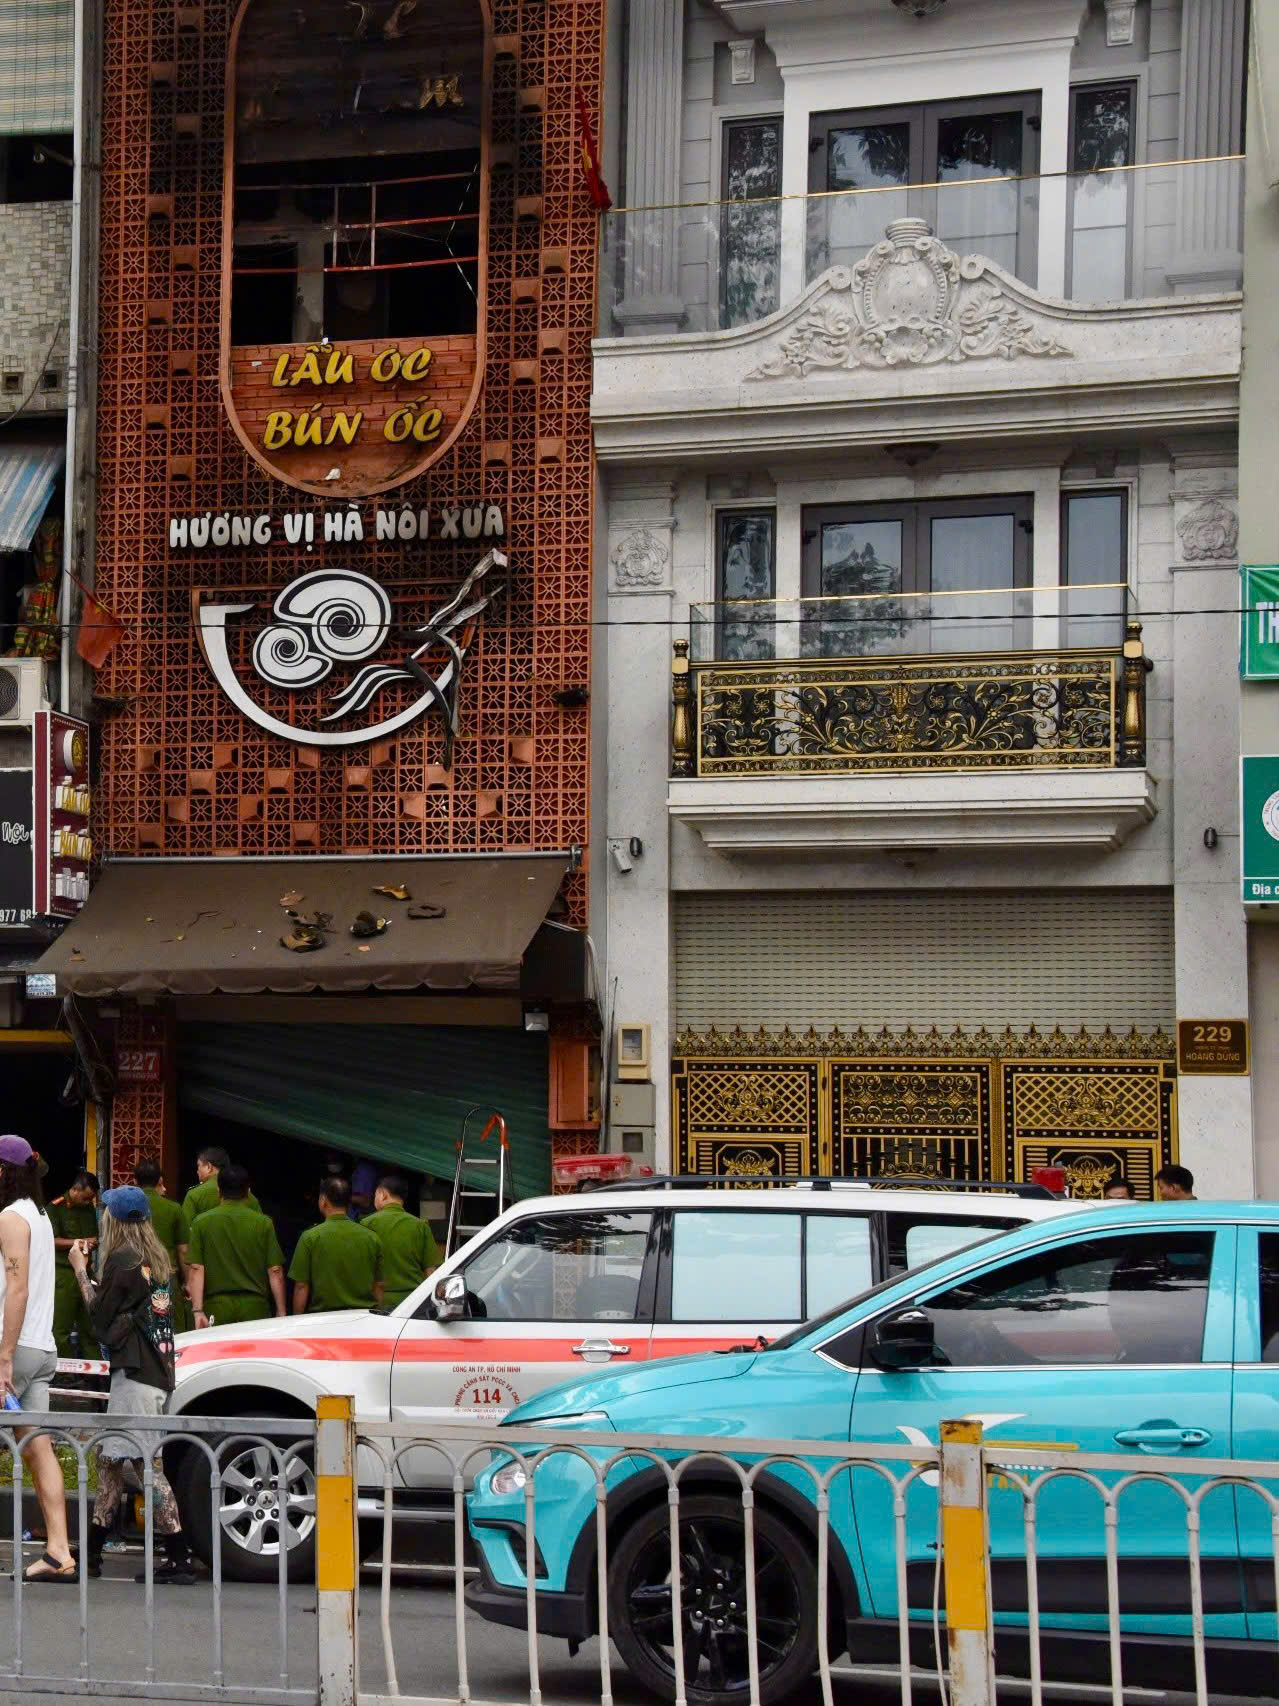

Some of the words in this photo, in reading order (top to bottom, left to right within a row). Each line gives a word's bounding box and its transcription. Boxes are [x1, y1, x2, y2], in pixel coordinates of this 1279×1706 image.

[263, 402, 364, 450] BÚN
[383, 395, 443, 443] ỐC
[169, 512, 271, 548] HƯƠNG
[283, 513, 315, 551] VỊ
[323, 503, 364, 542] HÀ
[440, 502, 505, 540] XƯA
[1252, 883, 1271, 897] Địa
[20, 909, 35, 922] 68
[1193, 1026, 1232, 1042] 229
[118, 1051, 158, 1071] 227
[473, 1388, 502, 1404] 114
